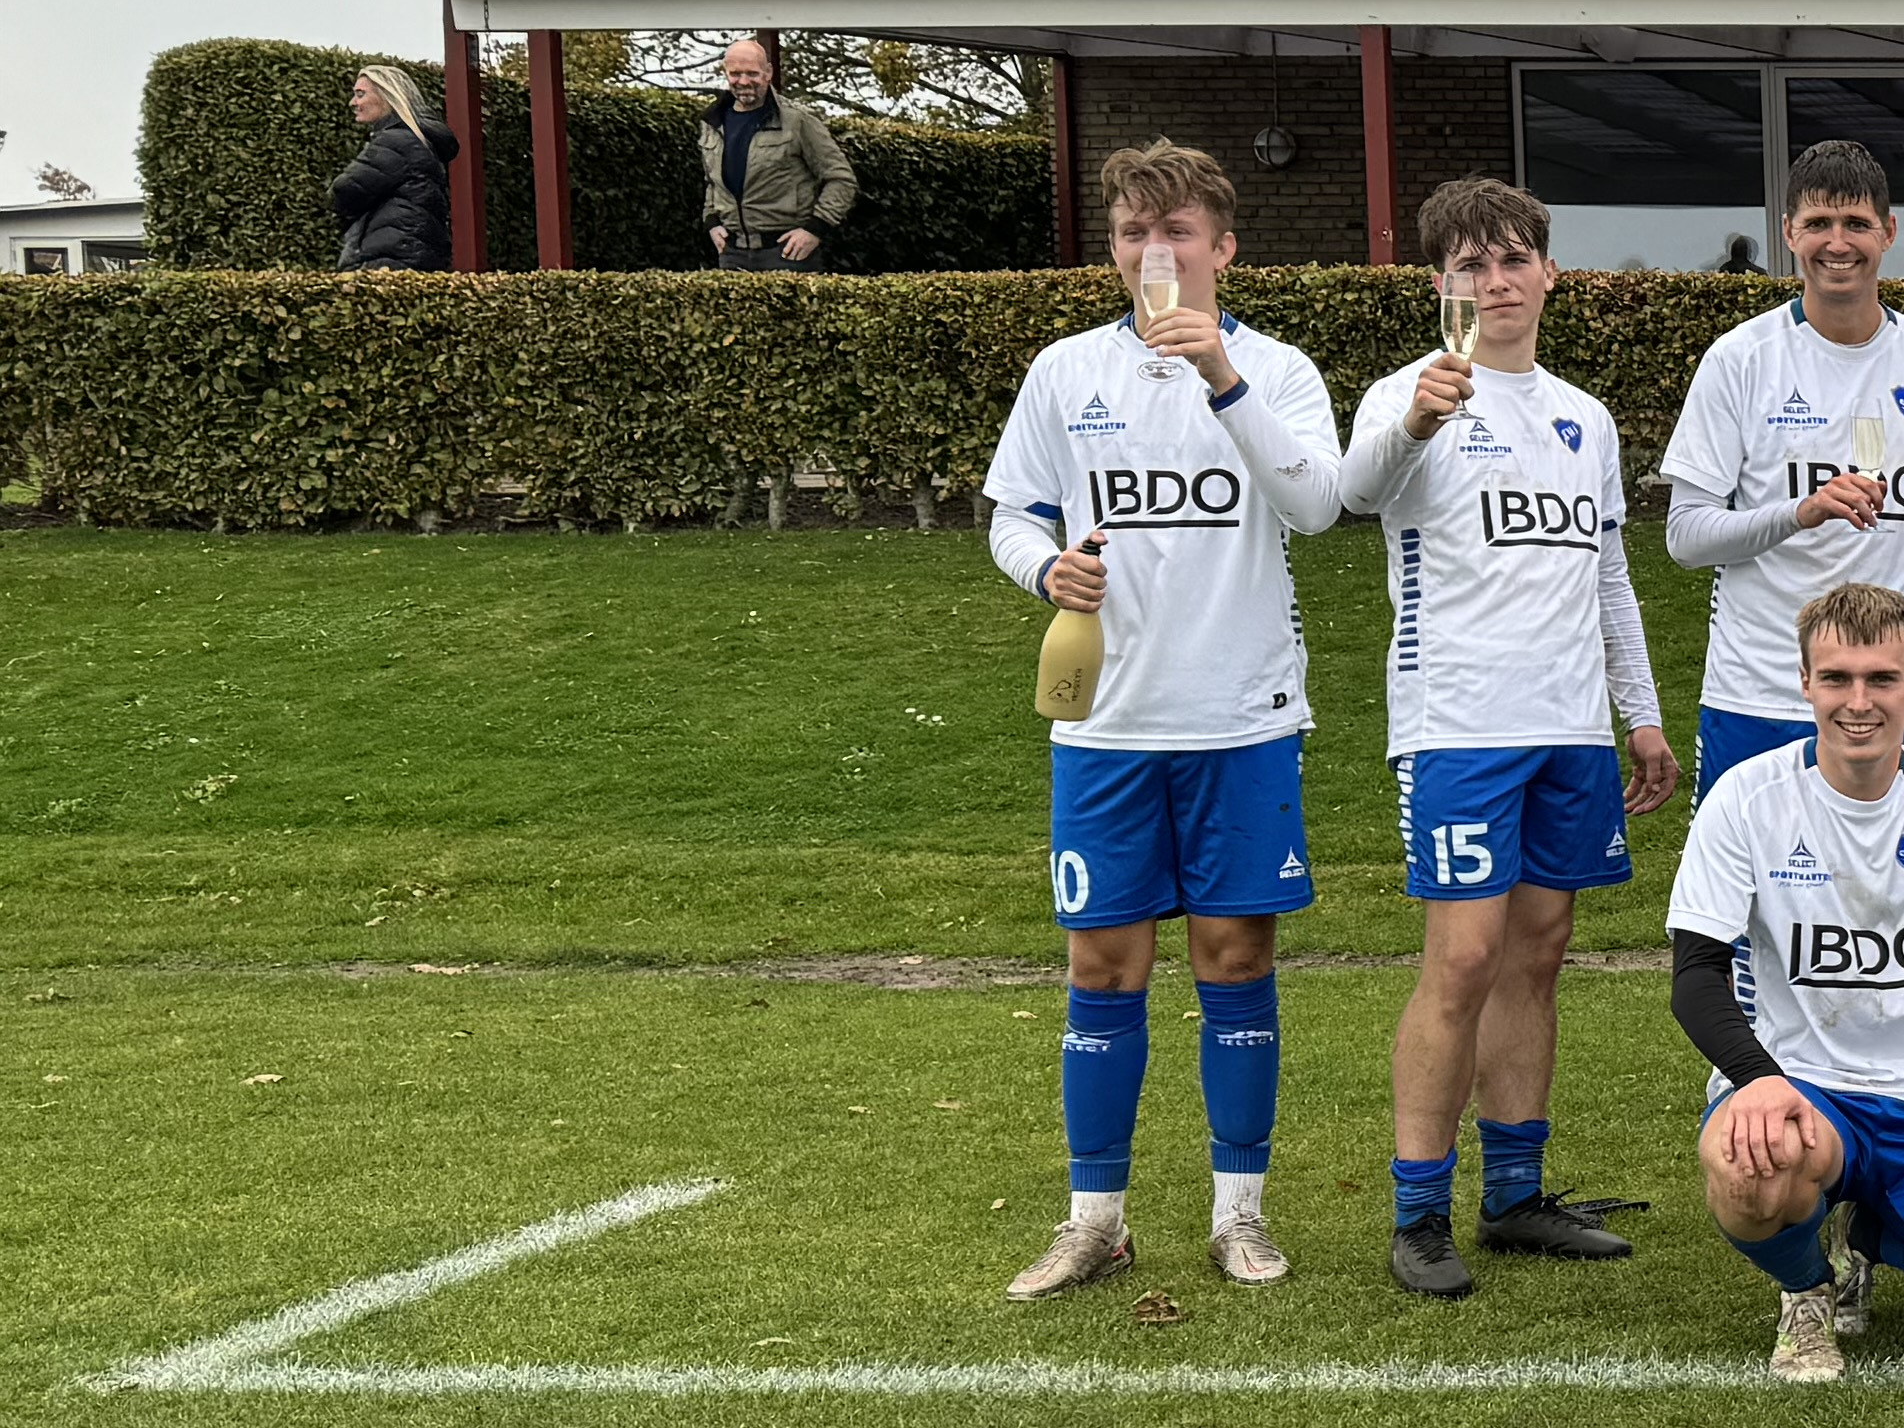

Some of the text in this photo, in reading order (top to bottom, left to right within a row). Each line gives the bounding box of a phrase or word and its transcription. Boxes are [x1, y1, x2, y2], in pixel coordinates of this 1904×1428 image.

[1104, 468, 1240, 515] BDO
[1498, 491, 1598, 537] BDO
[1431, 822, 1492, 885] 15
